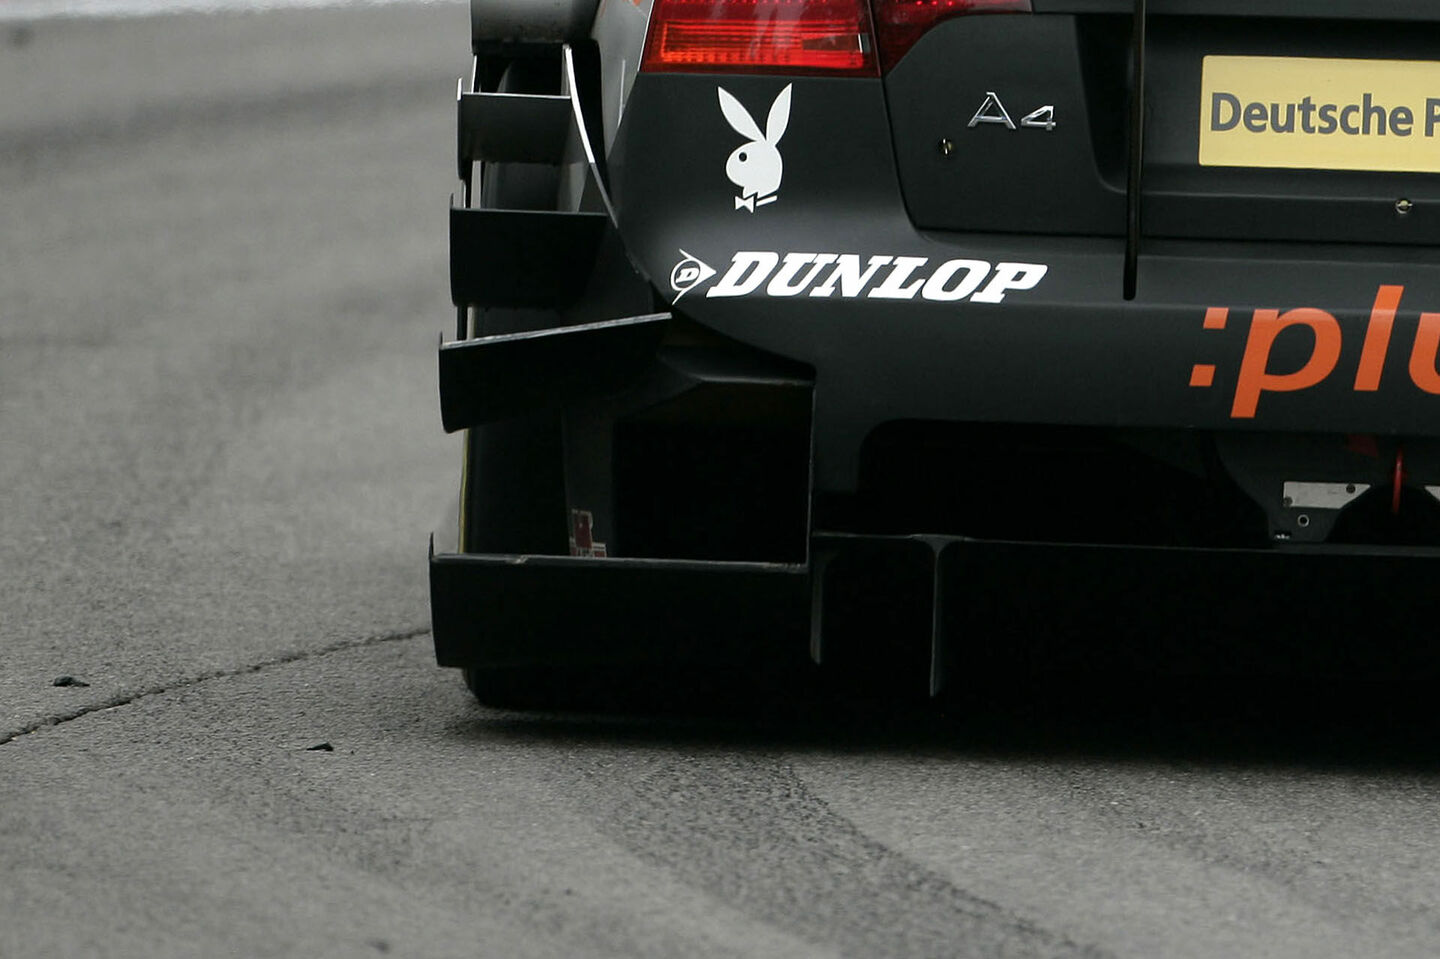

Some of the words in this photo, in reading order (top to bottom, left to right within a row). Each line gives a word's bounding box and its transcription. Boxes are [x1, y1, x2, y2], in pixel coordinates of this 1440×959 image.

[967, 91, 1057, 131] A4
[1210, 91, 1414, 137] Deutsche
[706, 251, 1048, 304] DUNLOP
